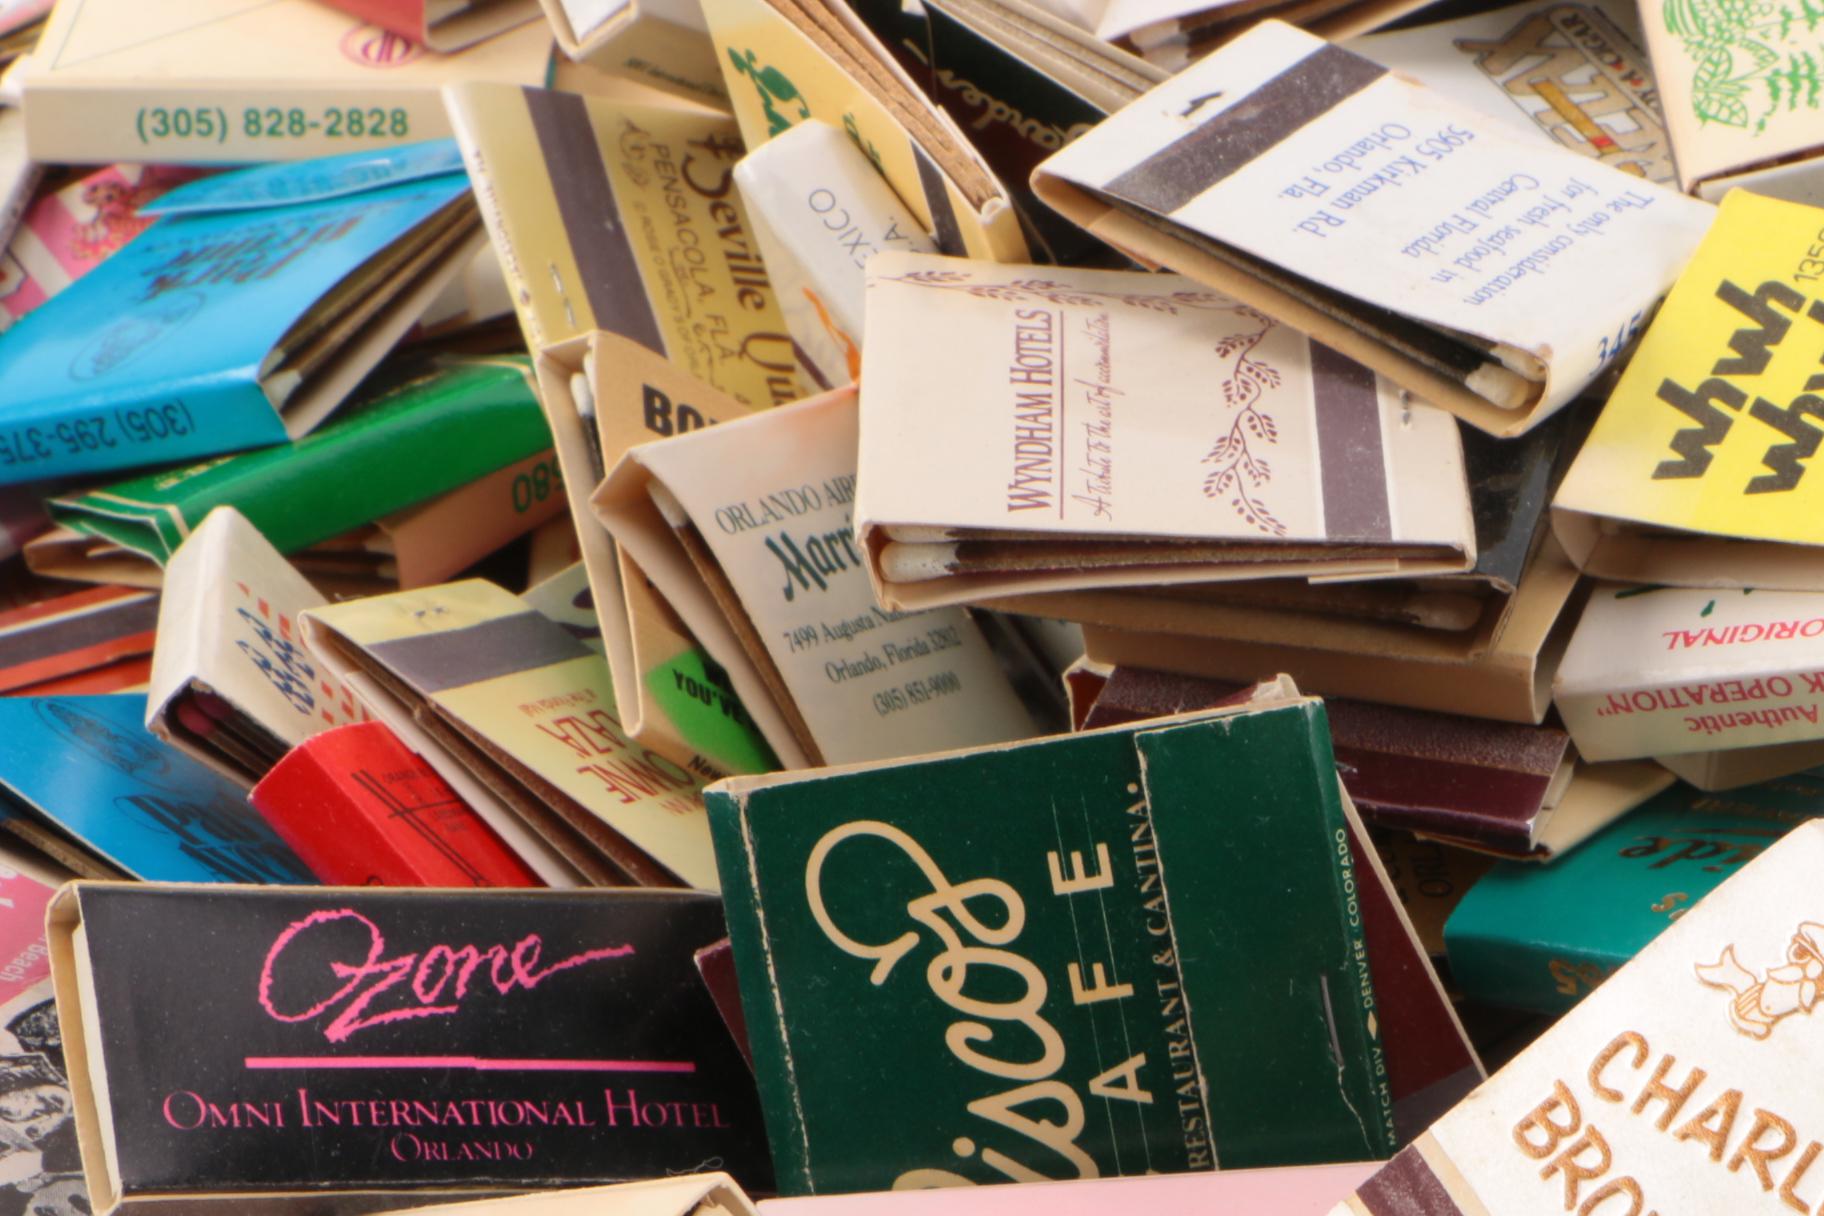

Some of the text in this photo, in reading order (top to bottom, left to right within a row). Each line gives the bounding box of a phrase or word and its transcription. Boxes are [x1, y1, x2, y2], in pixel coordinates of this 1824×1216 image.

[136, 107, 409, 142] (305) 828-2828
[1276, 121, 1413, 203] Orlando, Fla.
[1293, 122, 1475, 240] 5905 Kirkman Rd.
[1400, 171, 1541, 262] Central Florida
[1457, 222, 1524, 271] seafood
[1461, 231, 1577, 308] consideration
[1007, 308, 1054, 512] WYNDHAM HOTELS
[714, 480, 825, 536] ORLANDO
[824, 649, 886, 686] Orlando,
[1596, 672, 1795, 717] OPERATION"
[1683, 705, 1821, 736] Authentic
[1335, 828, 1362, 928] COLORADO
[259, 908, 635, 1042] Ozone
[1349, 938, 1376, 1009] DENVER
[162, 1088, 731, 1130] OMNI INTERNATIONAL HOTEL
[390, 1132, 535, 1162] ORLANDO
